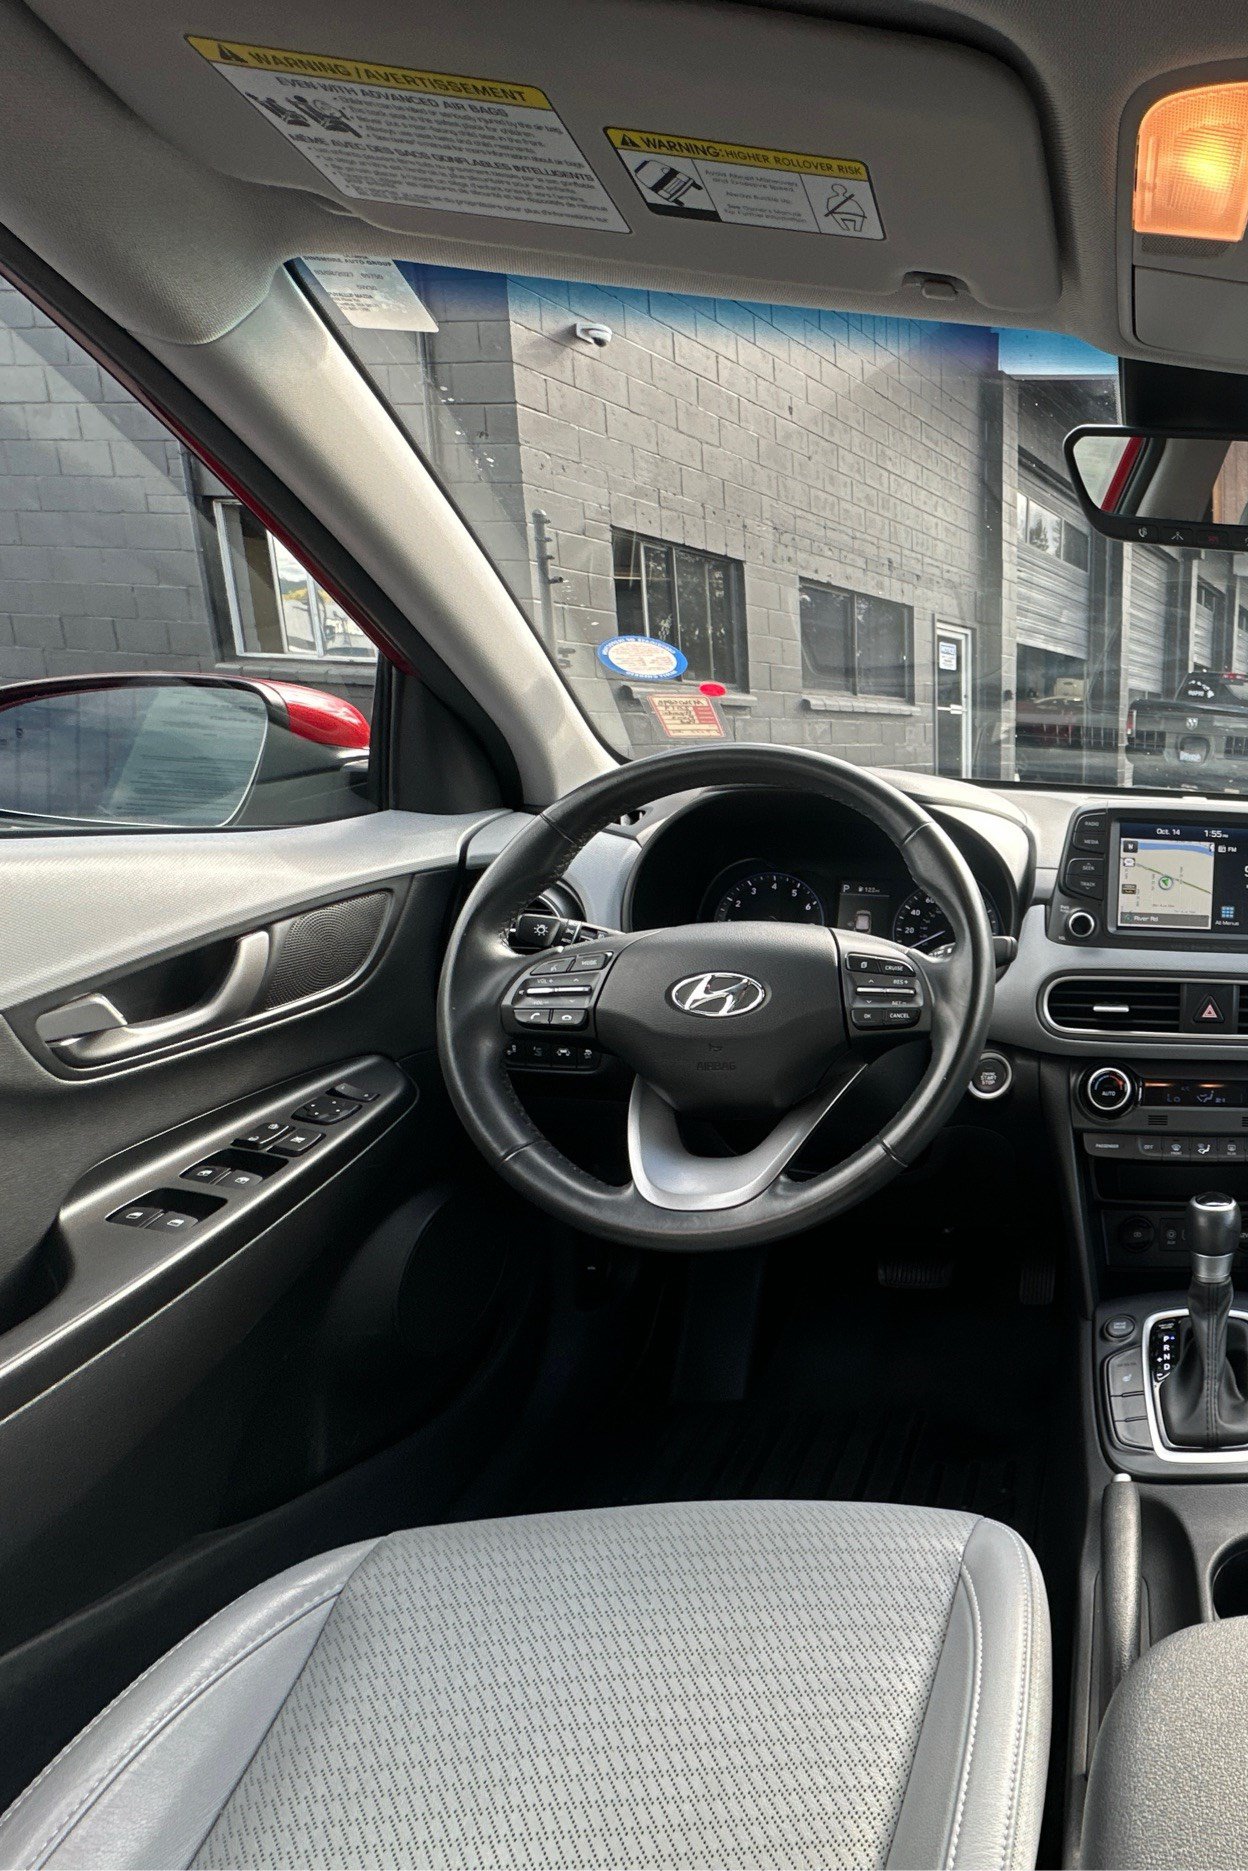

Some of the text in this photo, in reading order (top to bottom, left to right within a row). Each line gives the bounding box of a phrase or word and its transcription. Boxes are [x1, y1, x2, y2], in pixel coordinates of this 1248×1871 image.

[249, 50, 351, 77] WARNING
[275, 76, 509, 118] EVEN WITH ADVANCED AIR BAGS
[725, 150, 770, 165] HIGHER
[774, 156, 834, 173] ROLLOVER
[837, 164, 862, 176] RISK
[771, 882, 777, 890] 4
[842, 884, 851, 892] P
[751, 887, 757, 895] 3
[791, 889, 798, 897] 5
[735, 900, 741, 908] 2
[805, 903, 811, 911] 6
[1163, 1335, 1169, 1343] P
[1163, 1363, 1171, 1371] D
